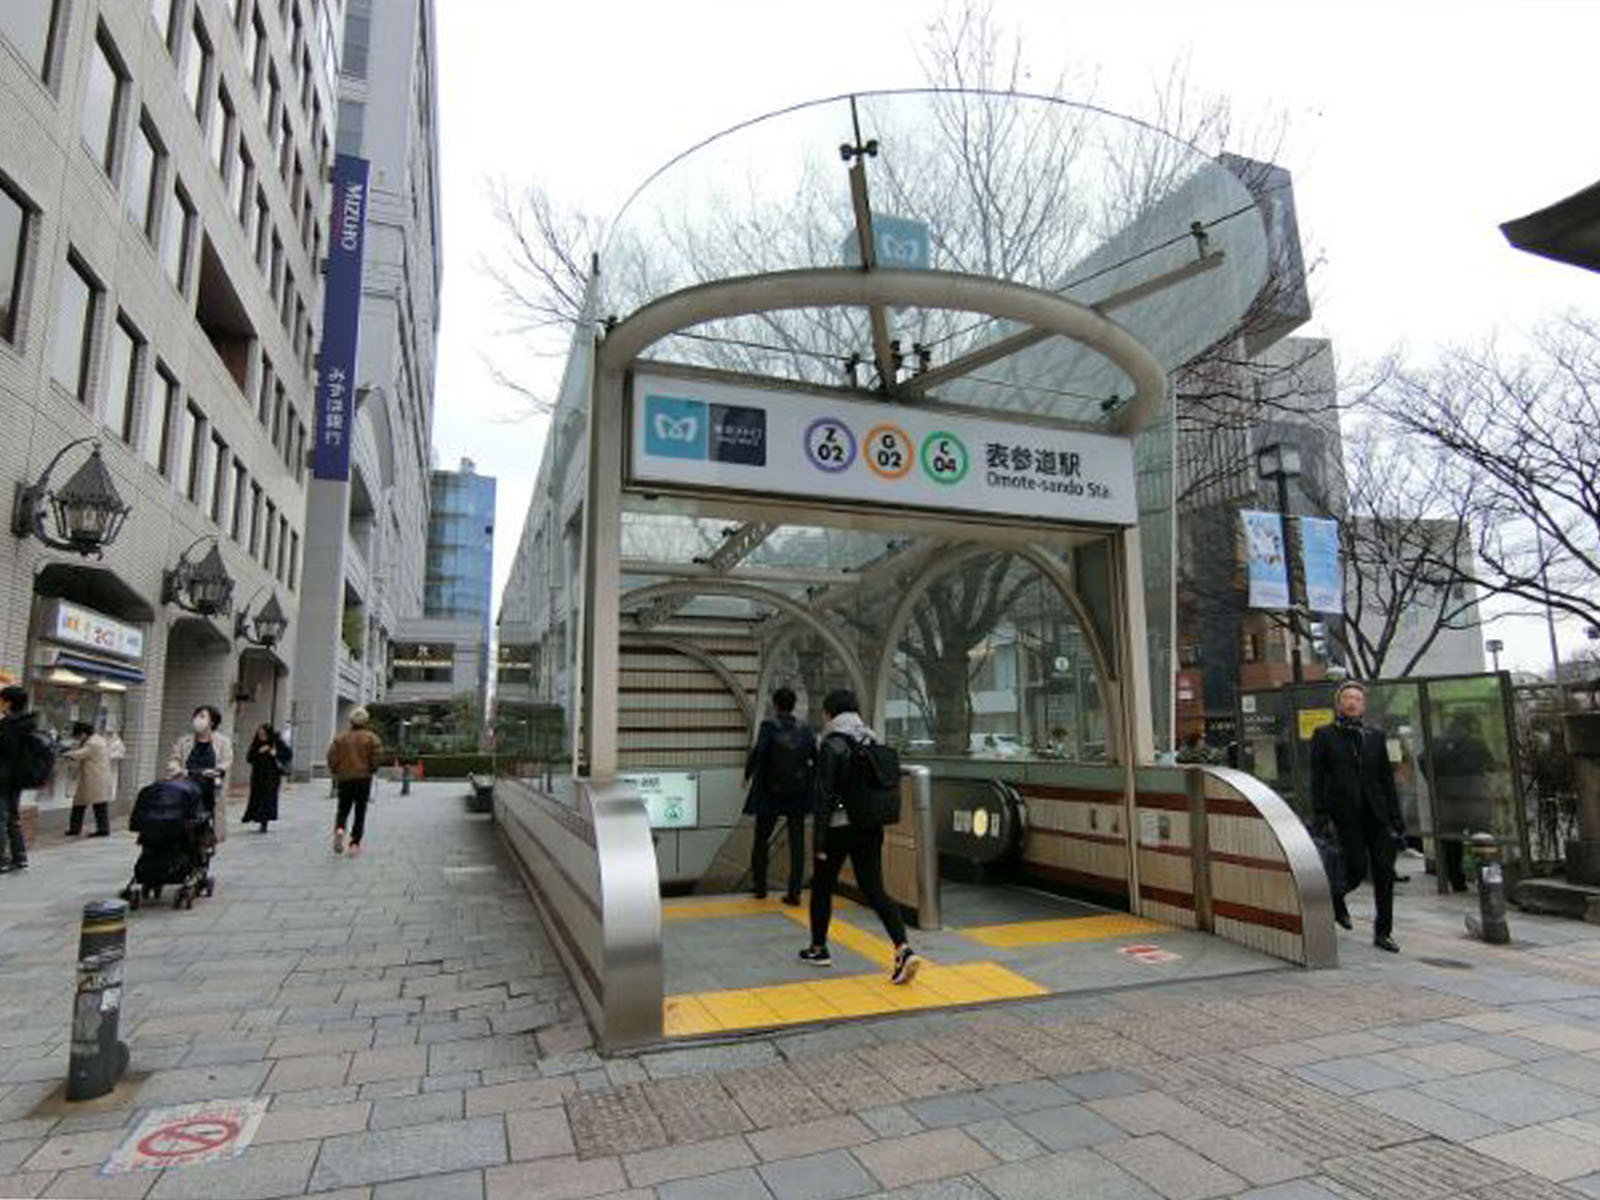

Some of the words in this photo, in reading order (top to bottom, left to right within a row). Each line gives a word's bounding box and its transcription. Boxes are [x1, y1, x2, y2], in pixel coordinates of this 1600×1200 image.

[342, 183, 363, 251] MIZUHO
[825, 427, 836, 443] Z
[882, 434, 896, 450] G
[817, 443, 844, 462] 02
[939, 441, 950, 456] C
[877, 450, 903, 468] 02
[932, 456, 957, 473] 04
[985, 442, 1082, 478] 表参道駅
[986, 471, 1085, 497] Omote-sando
